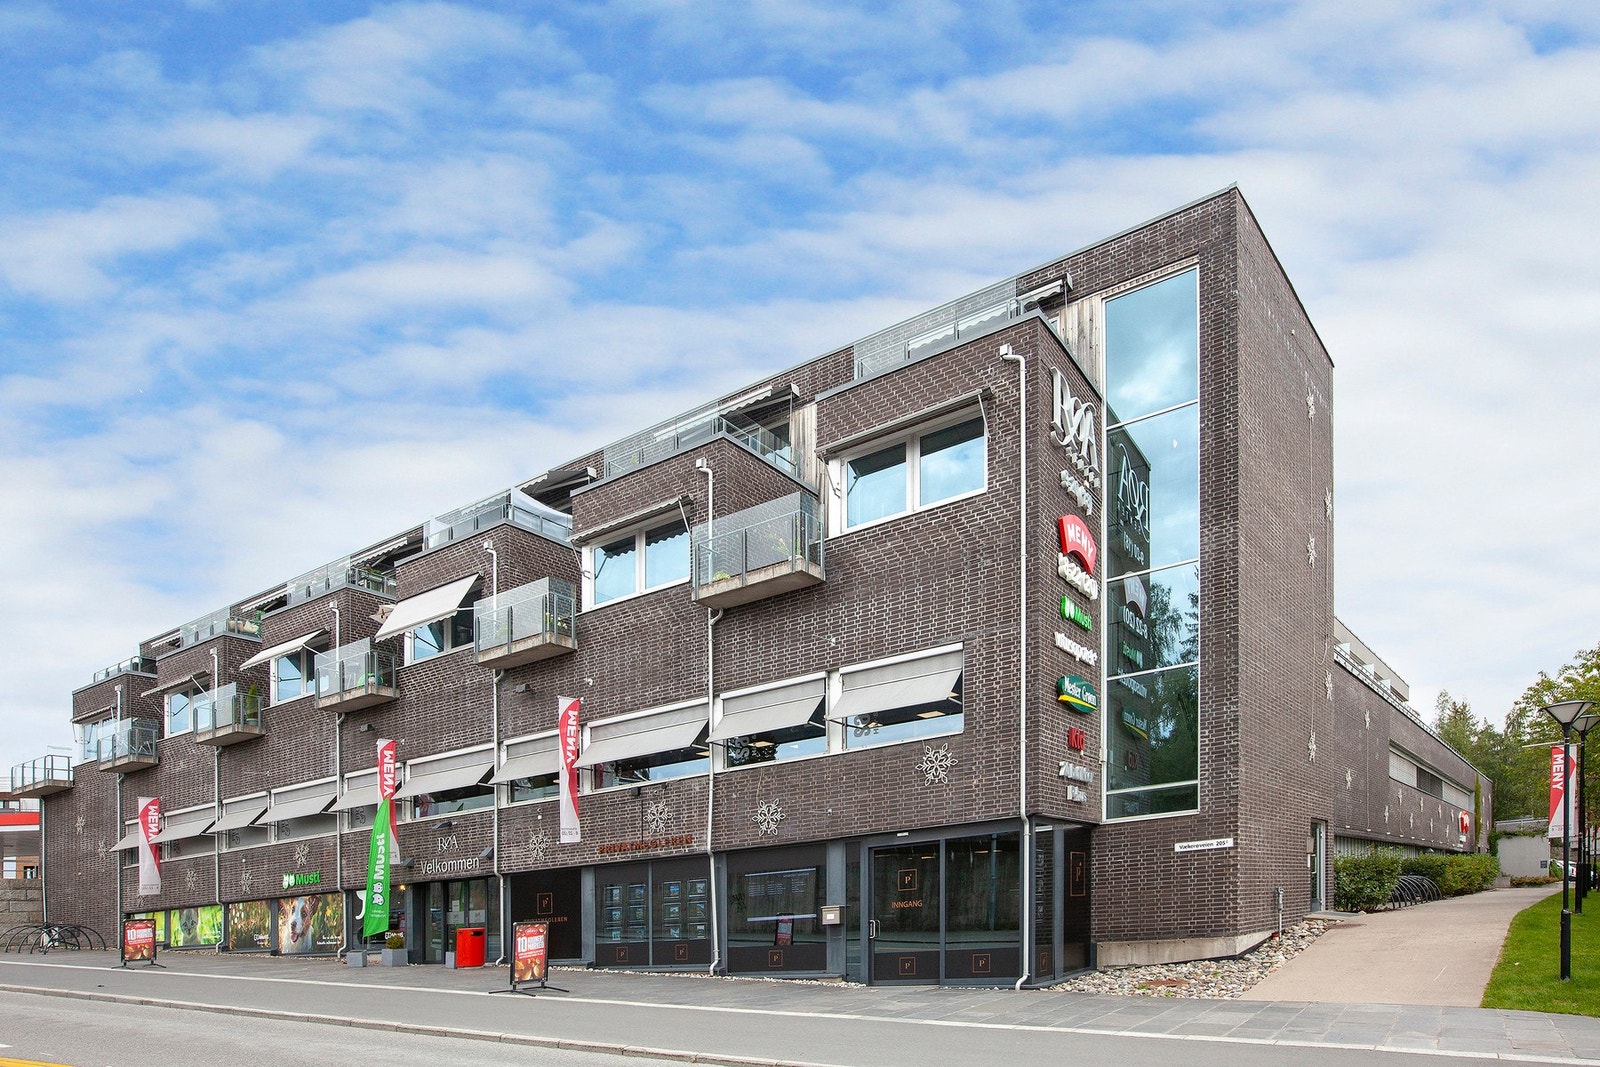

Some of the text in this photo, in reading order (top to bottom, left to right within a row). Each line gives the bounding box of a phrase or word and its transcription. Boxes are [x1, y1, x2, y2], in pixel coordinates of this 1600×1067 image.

[1067, 523, 1094, 559] MENY
[1074, 605, 1092, 632] Musti
[1064, 675, 1081, 699] Mester
[1068, 727, 1085, 750] Kid
[1552, 753, 1565, 791] MENY
[373, 833, 385, 880] Musti
[421, 857, 480, 875] Velkommen
[295, 870, 321, 886] Musti
[891, 899, 923, 909] INNGANG
